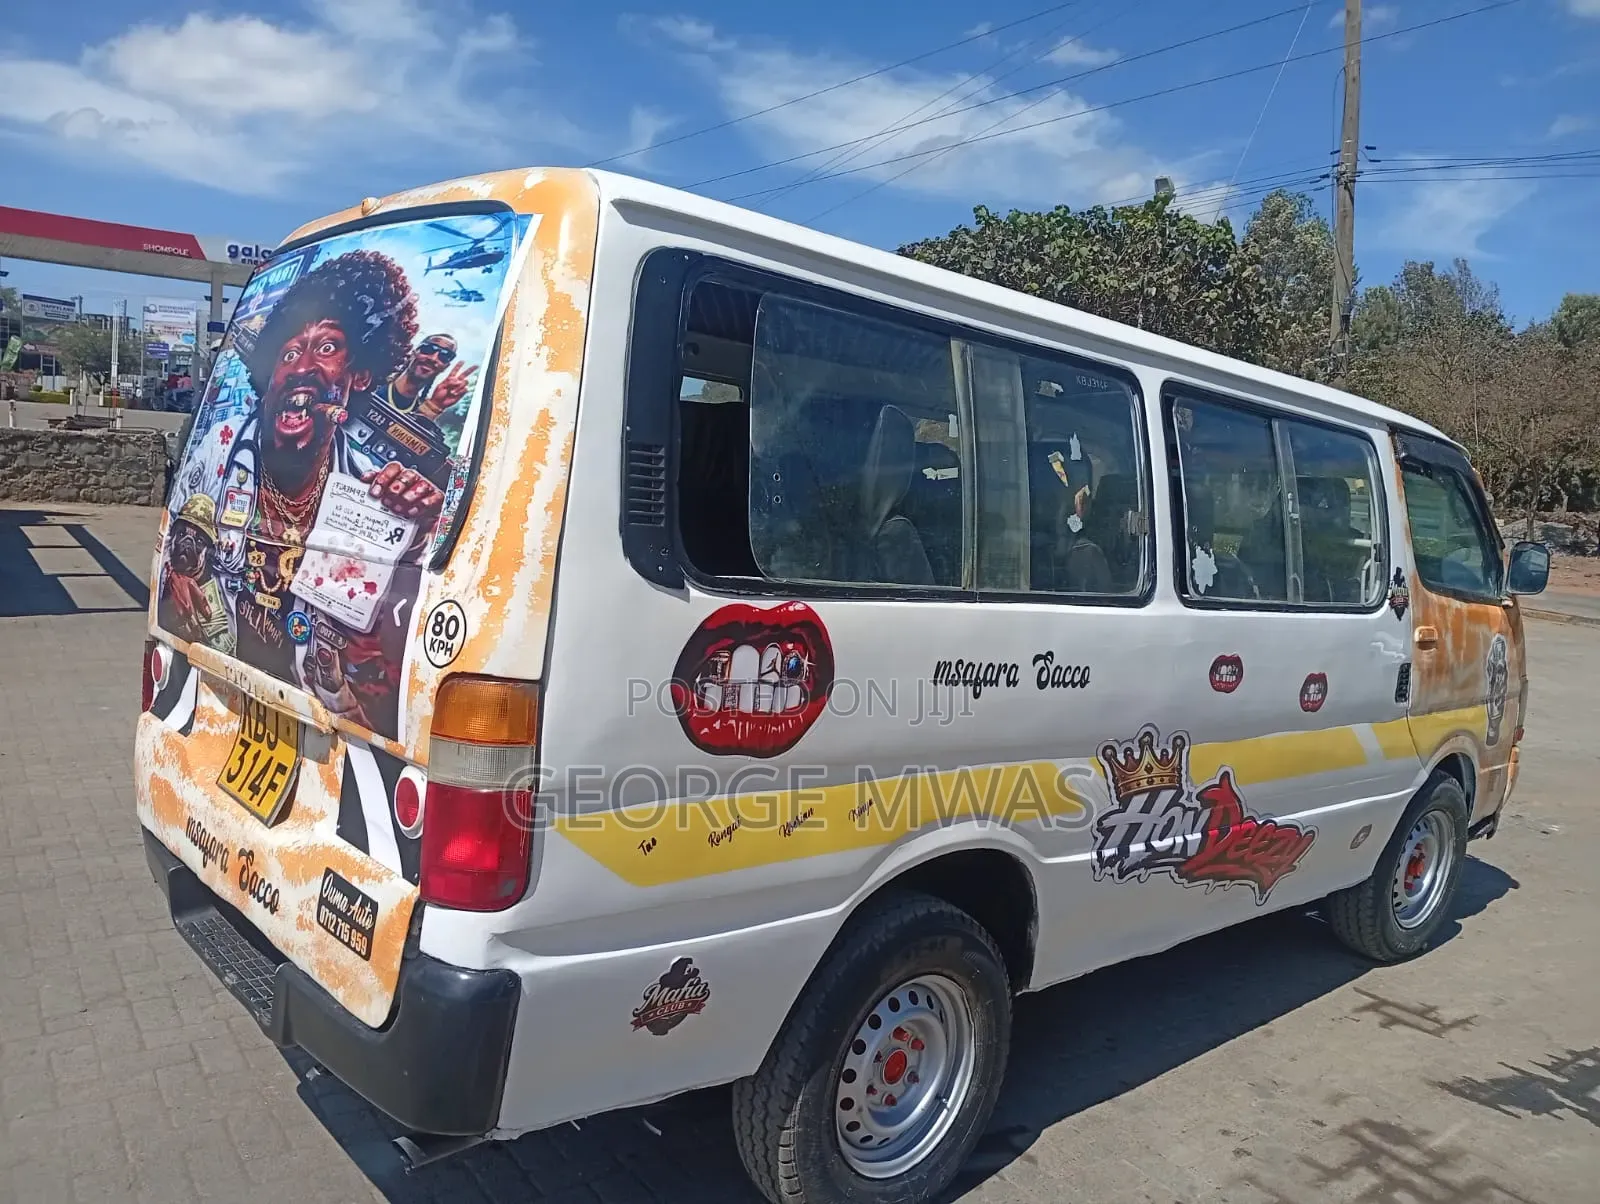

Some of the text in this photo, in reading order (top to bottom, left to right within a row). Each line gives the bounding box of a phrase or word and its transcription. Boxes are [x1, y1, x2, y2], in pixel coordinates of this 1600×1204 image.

[143, 243, 189, 257] SHOMPOLE
[429, 637, 454, 658] KPH
[432, 611, 459, 640] 80
[933, 650, 1091, 700] msafara Sacco
[241, 692, 279, 751] KBJ
[226, 737, 288, 807] 314F
[186, 815, 280, 915] msafara Sacco
[322, 873, 374, 930] Ouma Auto
[320, 905, 368, 956] 0712 715 959
[632, 977, 711, 1017] Mafia
[657, 1002, 685, 1015] CLUB
